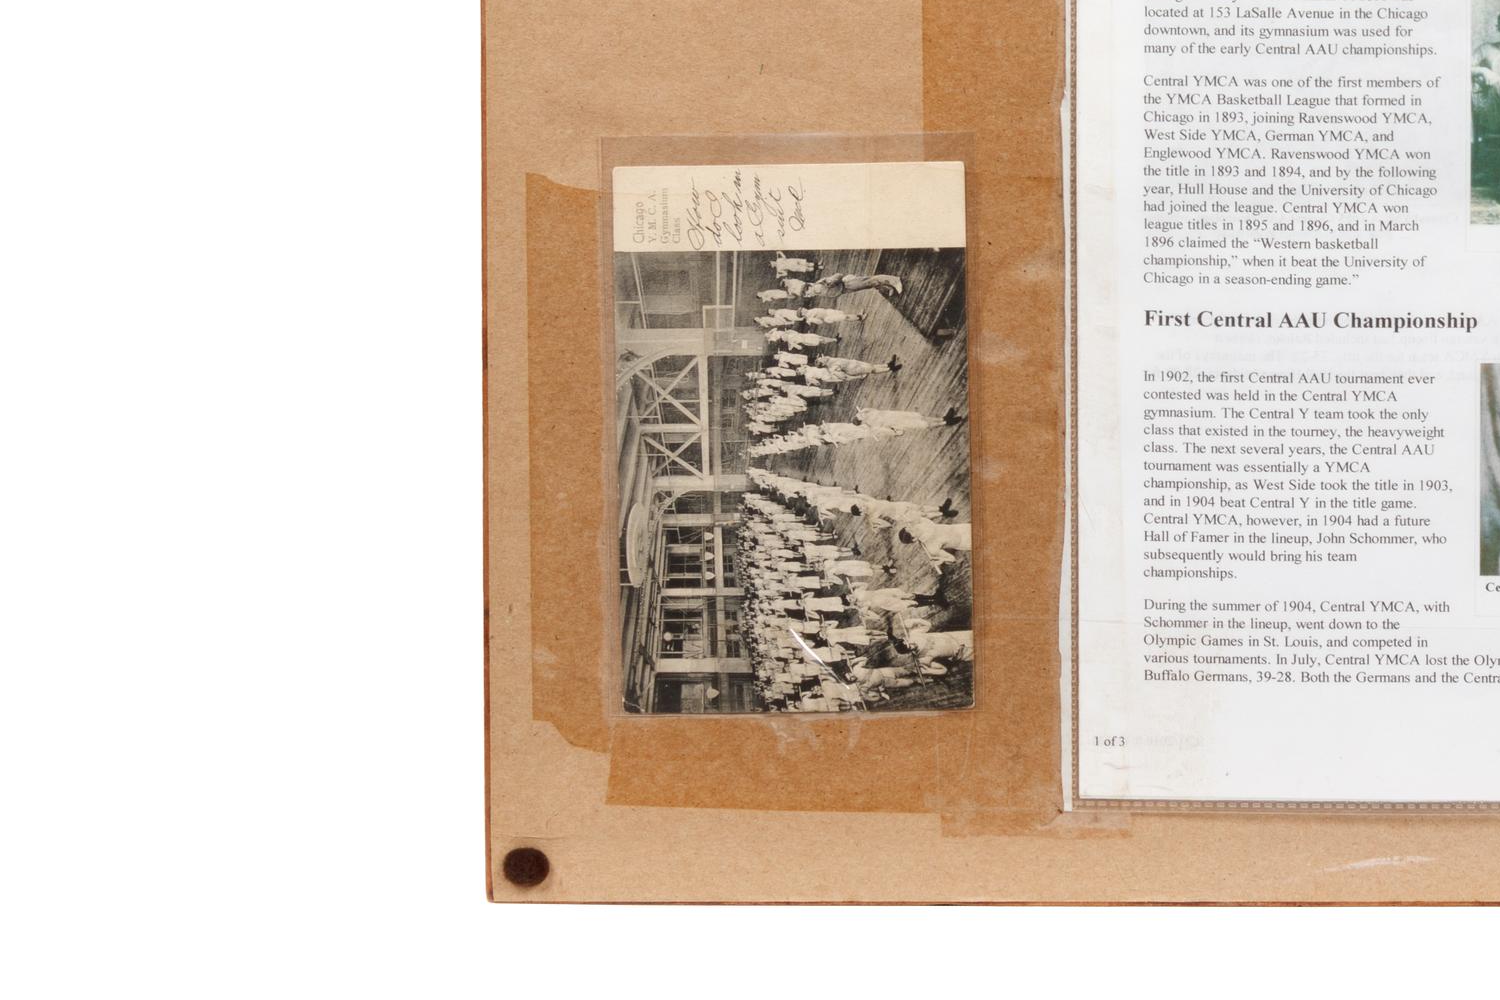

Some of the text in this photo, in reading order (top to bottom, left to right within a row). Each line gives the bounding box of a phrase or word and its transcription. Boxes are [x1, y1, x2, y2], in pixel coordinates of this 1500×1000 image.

[1144, 6, 1428, 22] located at 153 LaSalle Avenue in the Chicago
[1143, 110, 1432, 127] Chicago in 1893, joining Ravenswood YMCA,
[1144, 128, 1394, 143] West Side YMCA, German YMCA, and
[1144, 147, 1431, 162] Englewood YMCA. Ravenswood YMCA won
[632, 201, 645, 244] Chicago
[660, 187, 672, 244] Gymnasium
[672, 217, 681, 244] Class
[1145, 236, 1175, 248] 1896
[1178, 236, 1227, 248] claimed
[1231, 237, 1249, 249] the
[1315, 237, 1378, 250] basketball
[1144, 310, 1191, 327] First
[1196, 310, 1272, 328] Central
[1278, 312, 1327, 329] AAU
[1333, 312, 1478, 333] Championship
[1143, 389, 1398, 402] contested was held in the Central YMCA
[1143, 461, 1370, 476] tournament was essentially a YMCA
[1144, 548, 1357, 565] subsequently would bring his team
[1144, 651, 1189, 664] various
[1193, 654, 1271, 665] tournaments.
[1276, 653, 1287, 665] In
[1291, 653, 1321, 668] July,
[1325, 653, 1370, 665] Central
[1375, 654, 1420, 665] YMCA
[1425, 654, 1447, 666] lost
[1451, 654, 1470, 666] the
[1095, 736, 1125, 747] 1 of 3
